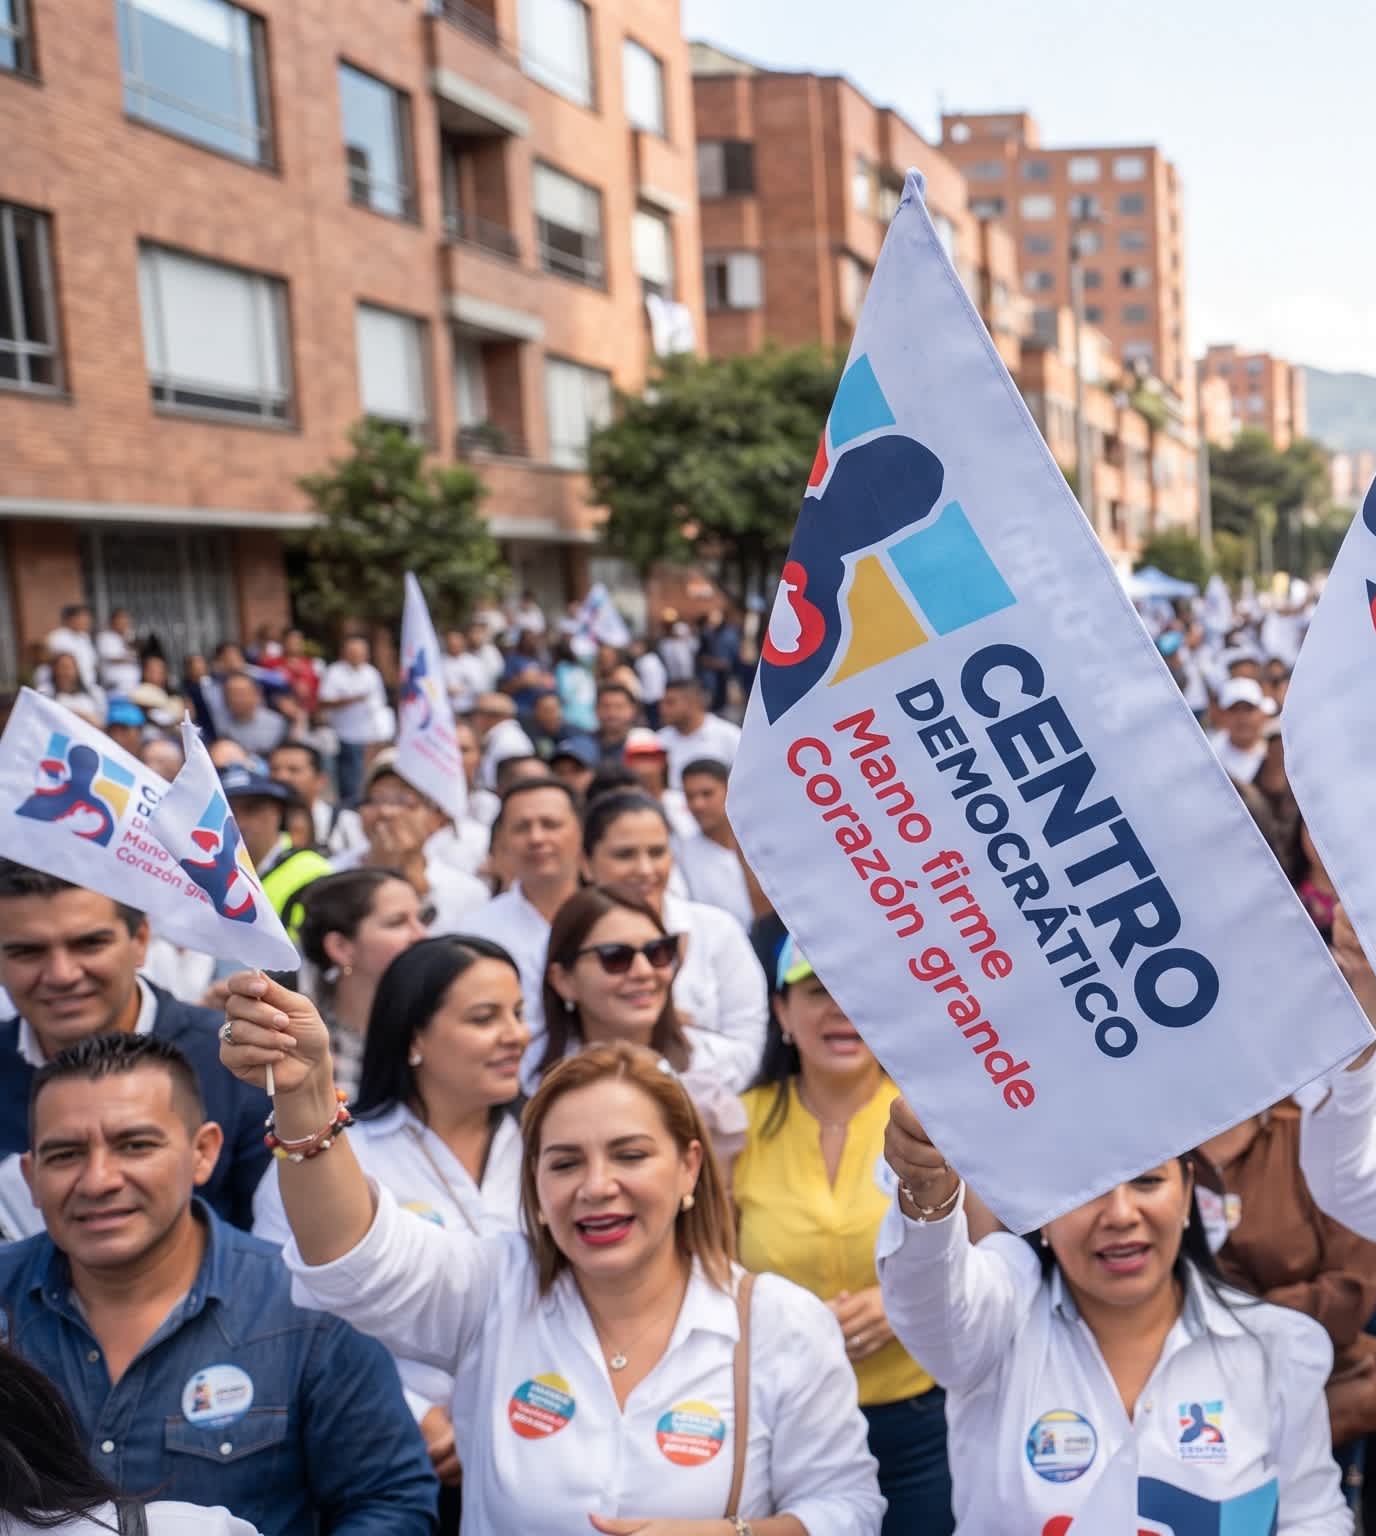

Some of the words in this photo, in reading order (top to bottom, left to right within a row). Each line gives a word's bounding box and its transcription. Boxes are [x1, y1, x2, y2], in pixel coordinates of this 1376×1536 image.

[787, 736, 925, 938] Corazón
[907, 946, 1036, 1109] grande
[832, 708, 932, 843] Mano
[922, 850, 1013, 980] firme
[895, 678, 1138, 1059] DEMOCRÁTICO
[960, 644, 1220, 1028] CENTRO
